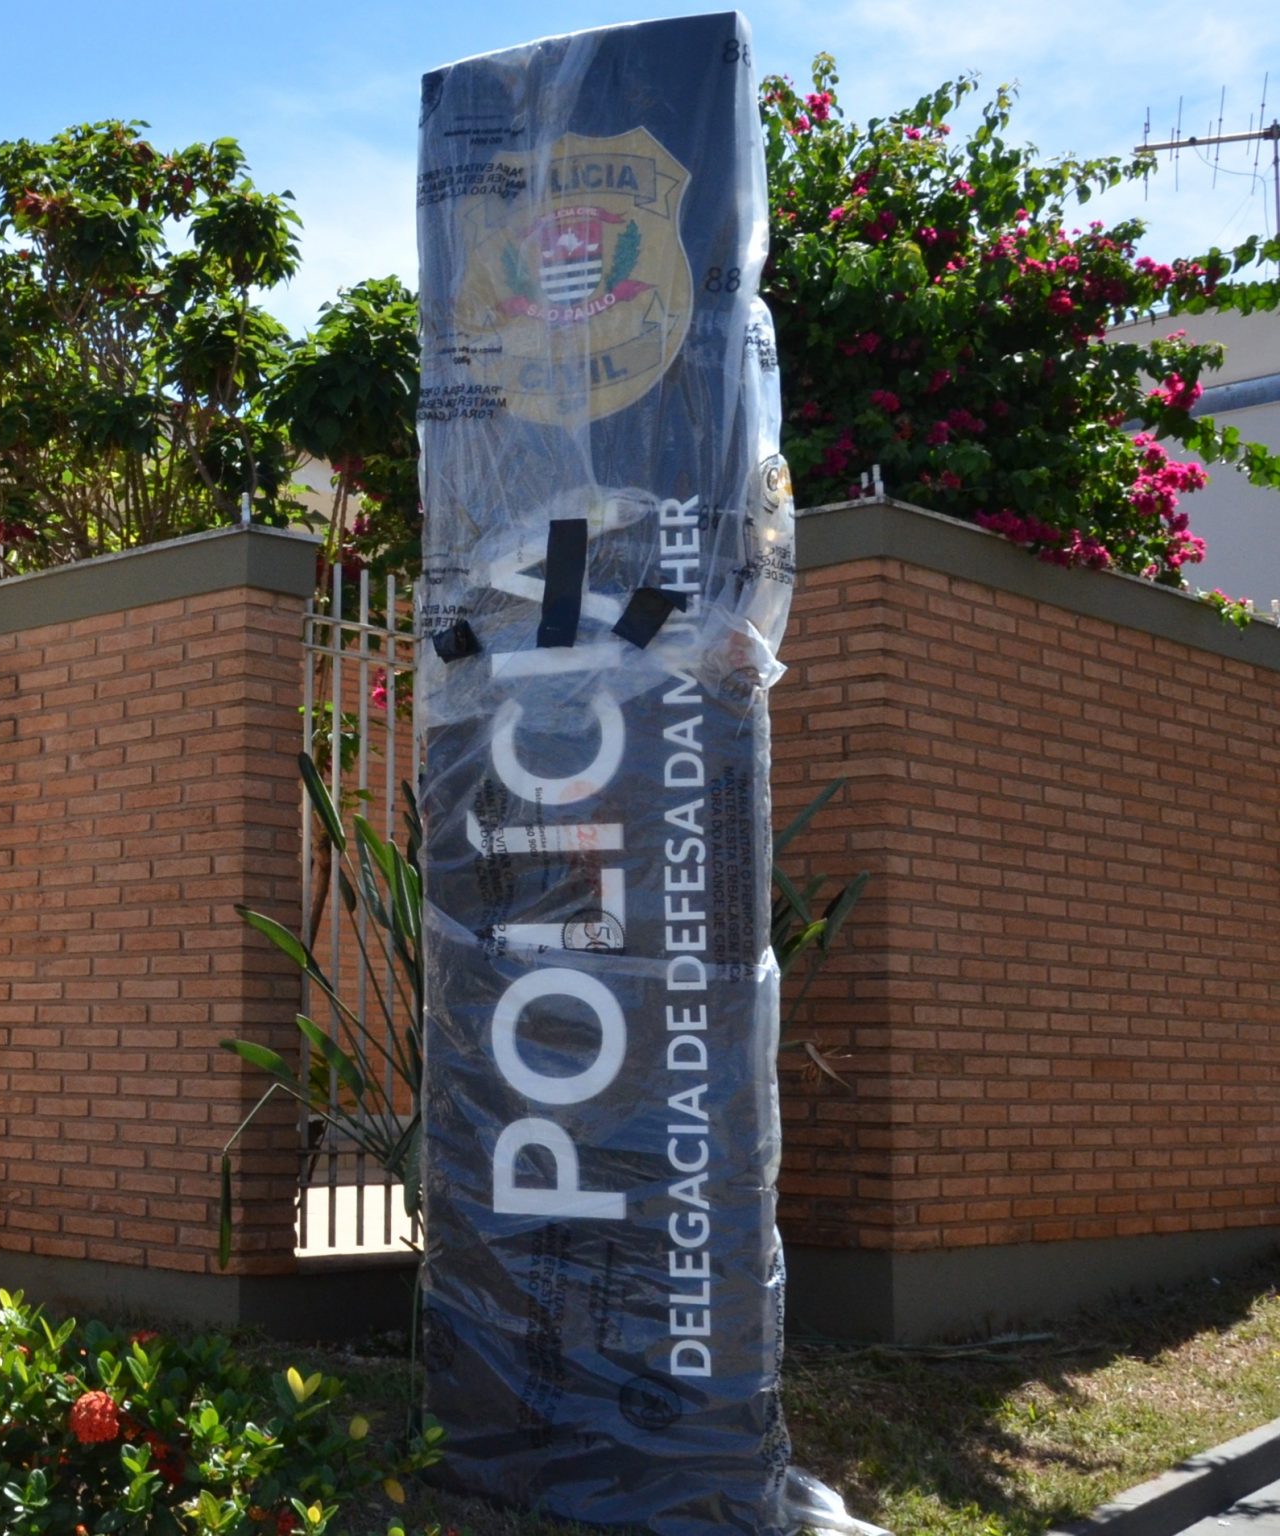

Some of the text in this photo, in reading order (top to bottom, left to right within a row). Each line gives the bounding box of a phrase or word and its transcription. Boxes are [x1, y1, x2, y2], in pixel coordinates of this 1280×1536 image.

[705, 265, 741, 294] 88
[563, 293, 616, 321] PAULO
[518, 353, 628, 390] CIVIL
[658, 494, 713, 1378] DELEGACIA DE DEFESA DA MULHER
